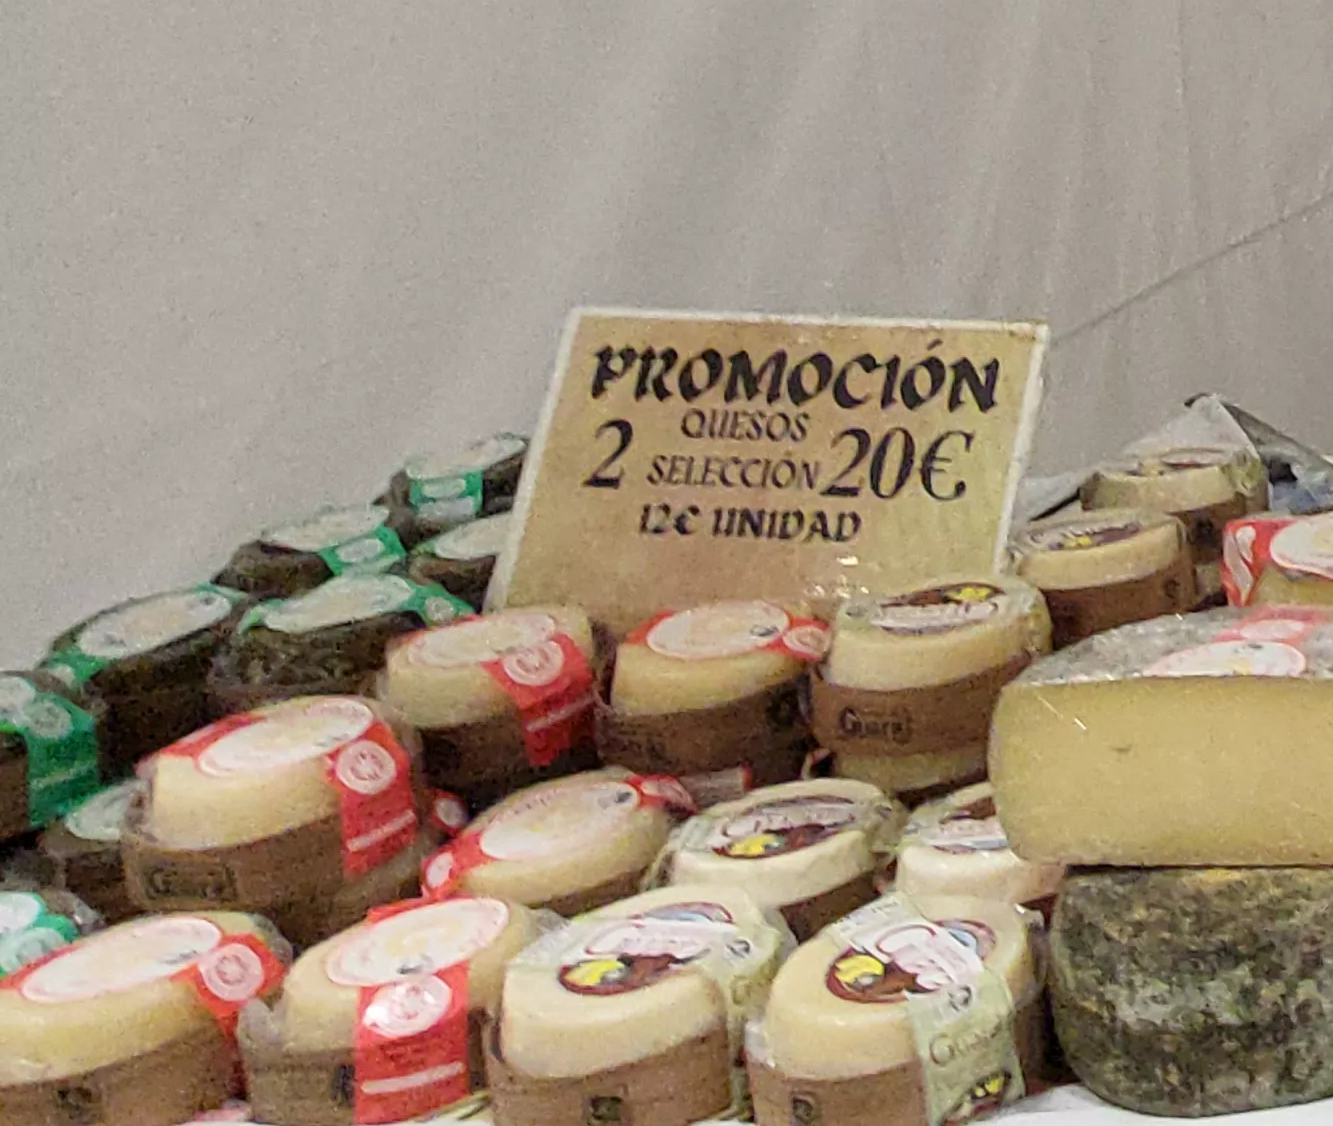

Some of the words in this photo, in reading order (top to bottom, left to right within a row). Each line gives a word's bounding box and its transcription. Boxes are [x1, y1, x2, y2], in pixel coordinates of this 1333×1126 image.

[590, 339, 1000, 413] PROMOCIÓN
[680, 408, 812, 442] QUESOS
[582, 419, 634, 490] 2
[646, 450, 820, 491] SELECCIÓN
[819, 426, 976, 501] 20€
[712, 506, 863, 543] UNIDAD
